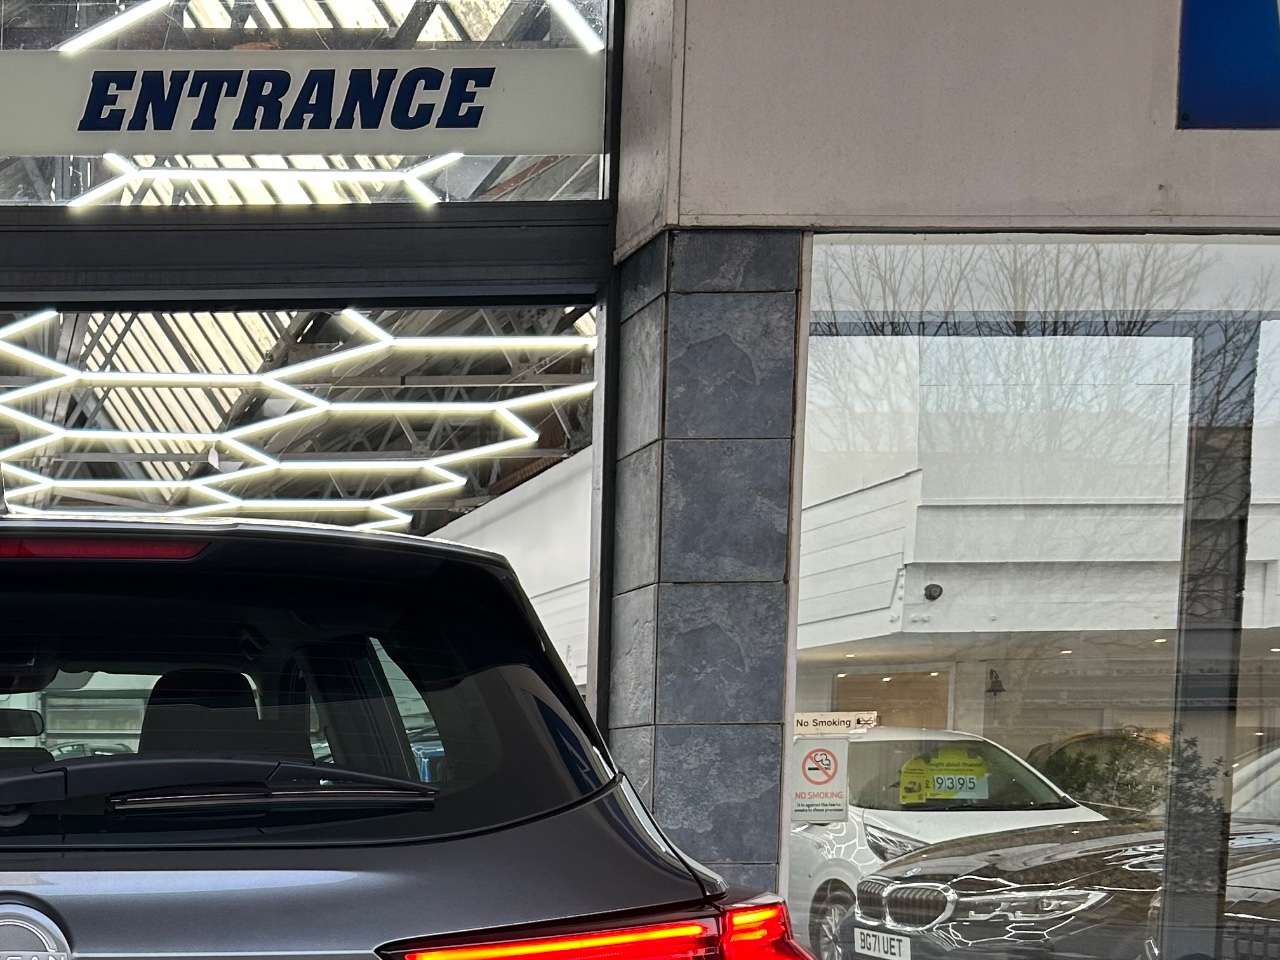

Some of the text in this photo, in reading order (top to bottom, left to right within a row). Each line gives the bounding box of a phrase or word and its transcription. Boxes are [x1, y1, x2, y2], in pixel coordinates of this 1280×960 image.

[77, 67, 496, 131] ENTRANCE
[796, 718, 851, 728] No Smoking
[860, 932, 903, 957] BG71 UET
